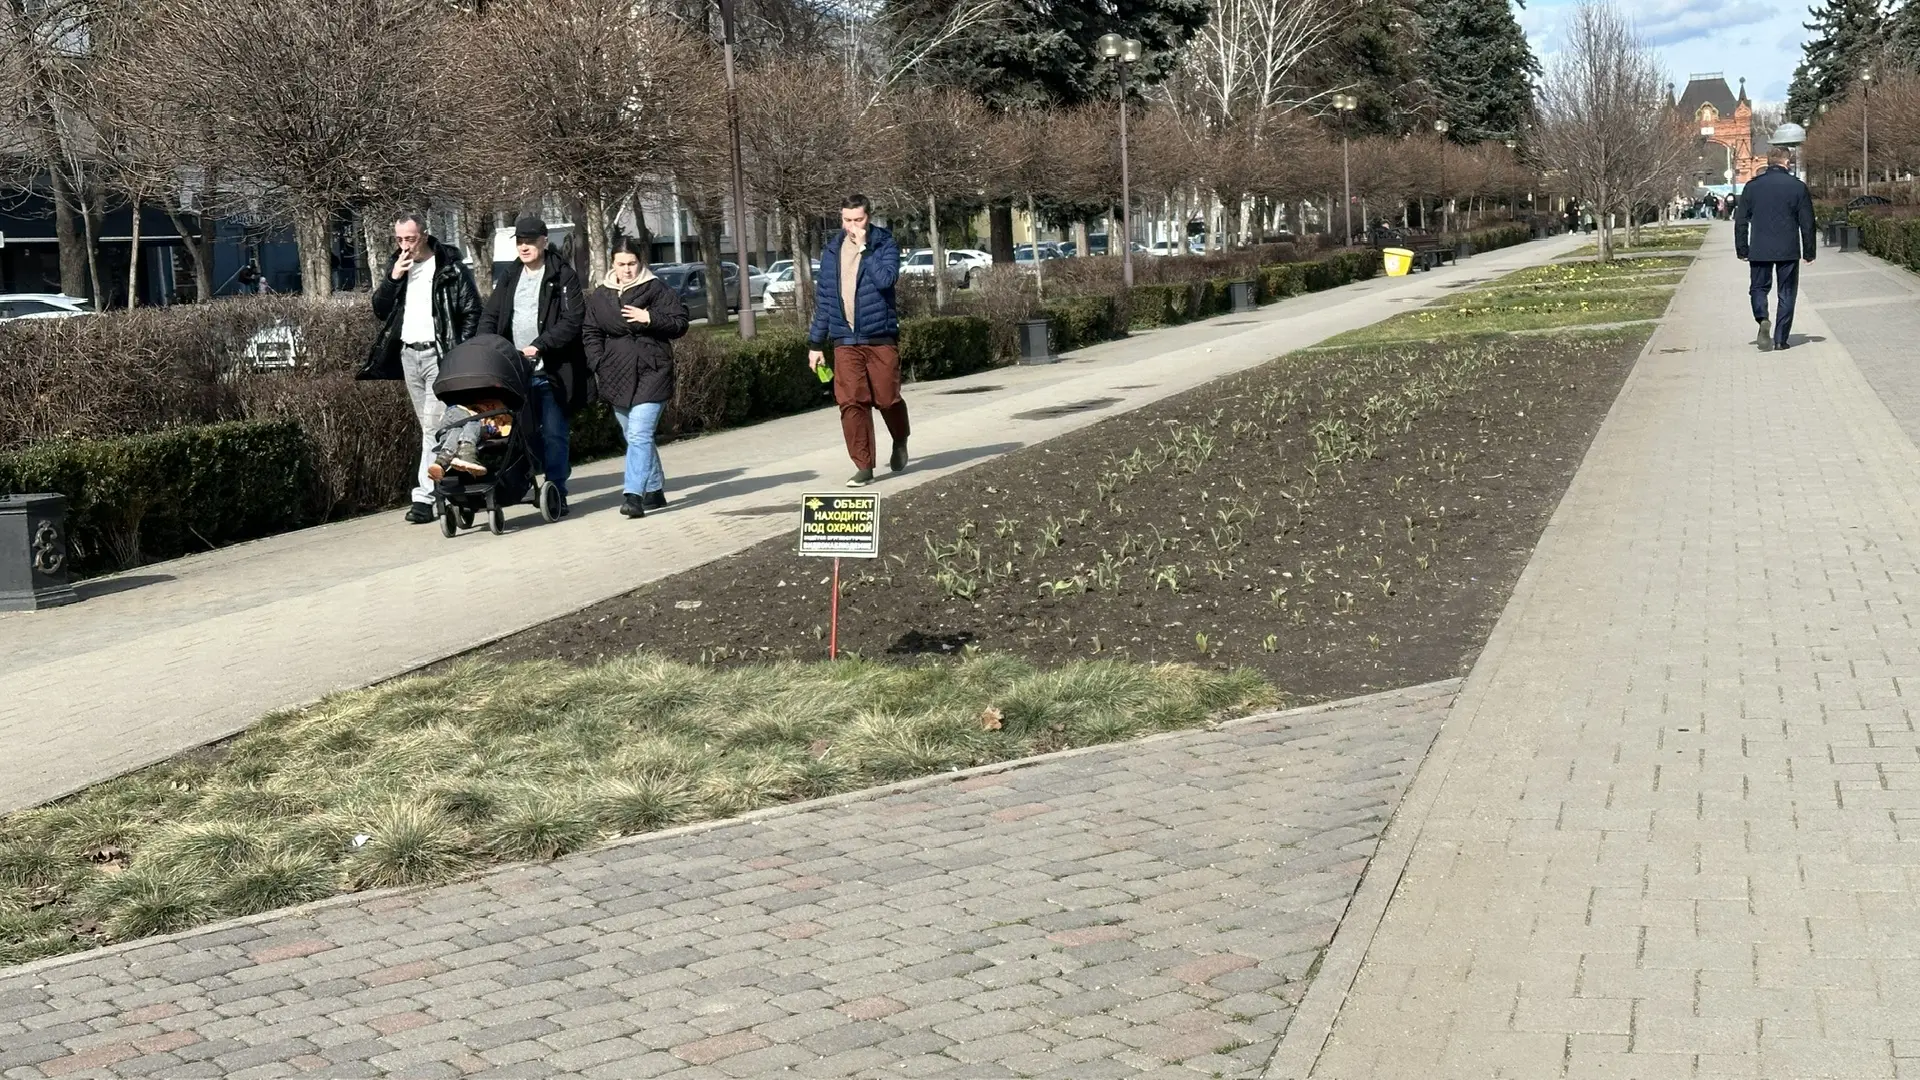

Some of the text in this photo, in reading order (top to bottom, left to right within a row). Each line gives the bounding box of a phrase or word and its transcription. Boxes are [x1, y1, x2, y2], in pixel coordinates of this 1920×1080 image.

[833, 499, 874, 509] ОБЪЕКТ
[814, 511, 874, 522] НАХОДИТСЯ
[804, 522, 873, 534] ПОД ОХРАНОЙ
